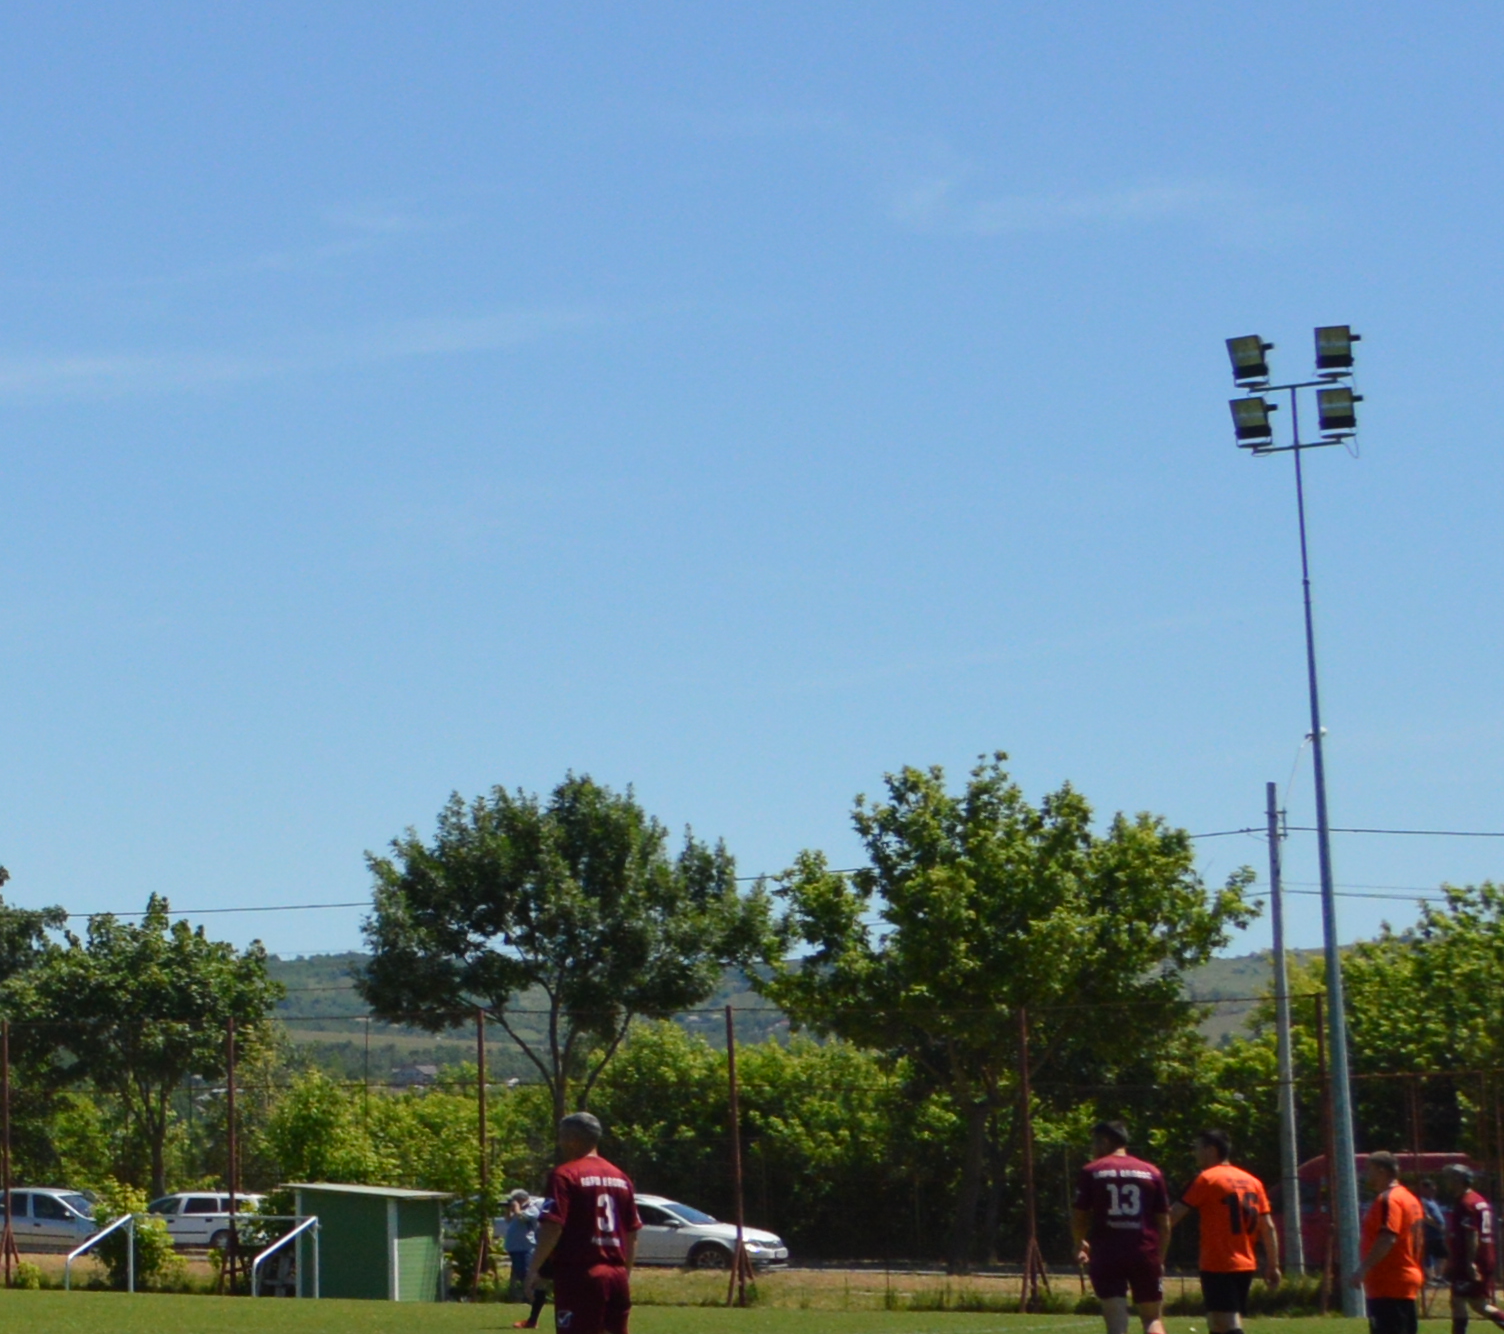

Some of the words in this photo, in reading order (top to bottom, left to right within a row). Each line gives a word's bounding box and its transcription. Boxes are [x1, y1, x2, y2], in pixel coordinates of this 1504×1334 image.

[597, 1193, 615, 1232] 3
[1106, 1183, 1140, 1216] 13
[1221, 1191, 1259, 1235] 16
